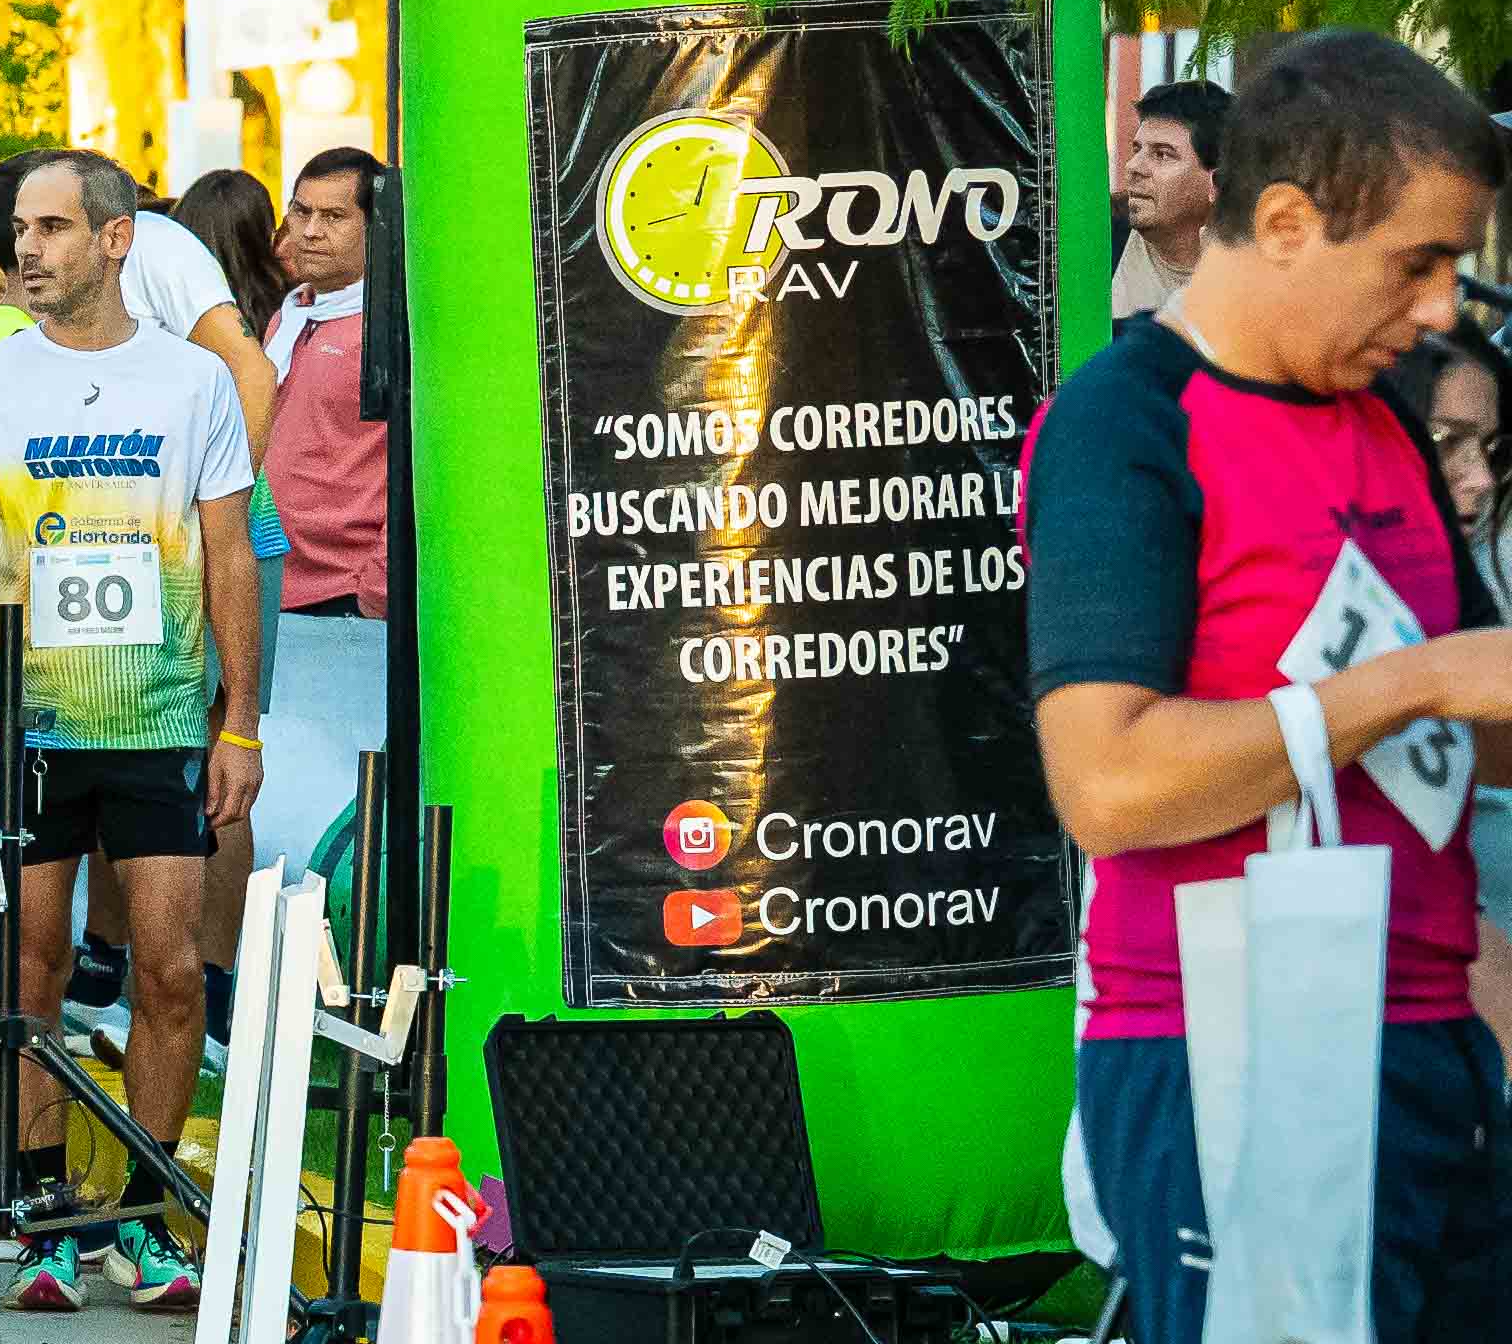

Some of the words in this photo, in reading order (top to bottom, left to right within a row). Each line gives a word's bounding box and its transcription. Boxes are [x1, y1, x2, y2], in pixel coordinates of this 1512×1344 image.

[727, 260, 858, 302] RAV
[24, 429, 165, 460] MARATÓN
[769, 395, 1016, 452] CORREDORES
[26, 457, 161, 480] ELORTONDO
[568, 482, 789, 538] BUSCANDO
[800, 472, 986, 527] MEJORAR
[70, 532, 153, 545] Elortondo
[57, 575, 133, 622] 80
[607, 553, 897, 611] EXPERIENCIAS
[909, 550, 954, 597] DE
[964, 545, 1026, 592] LOS
[756, 811, 997, 861] Cronorav
[759, 886, 1001, 936] Cronorav
